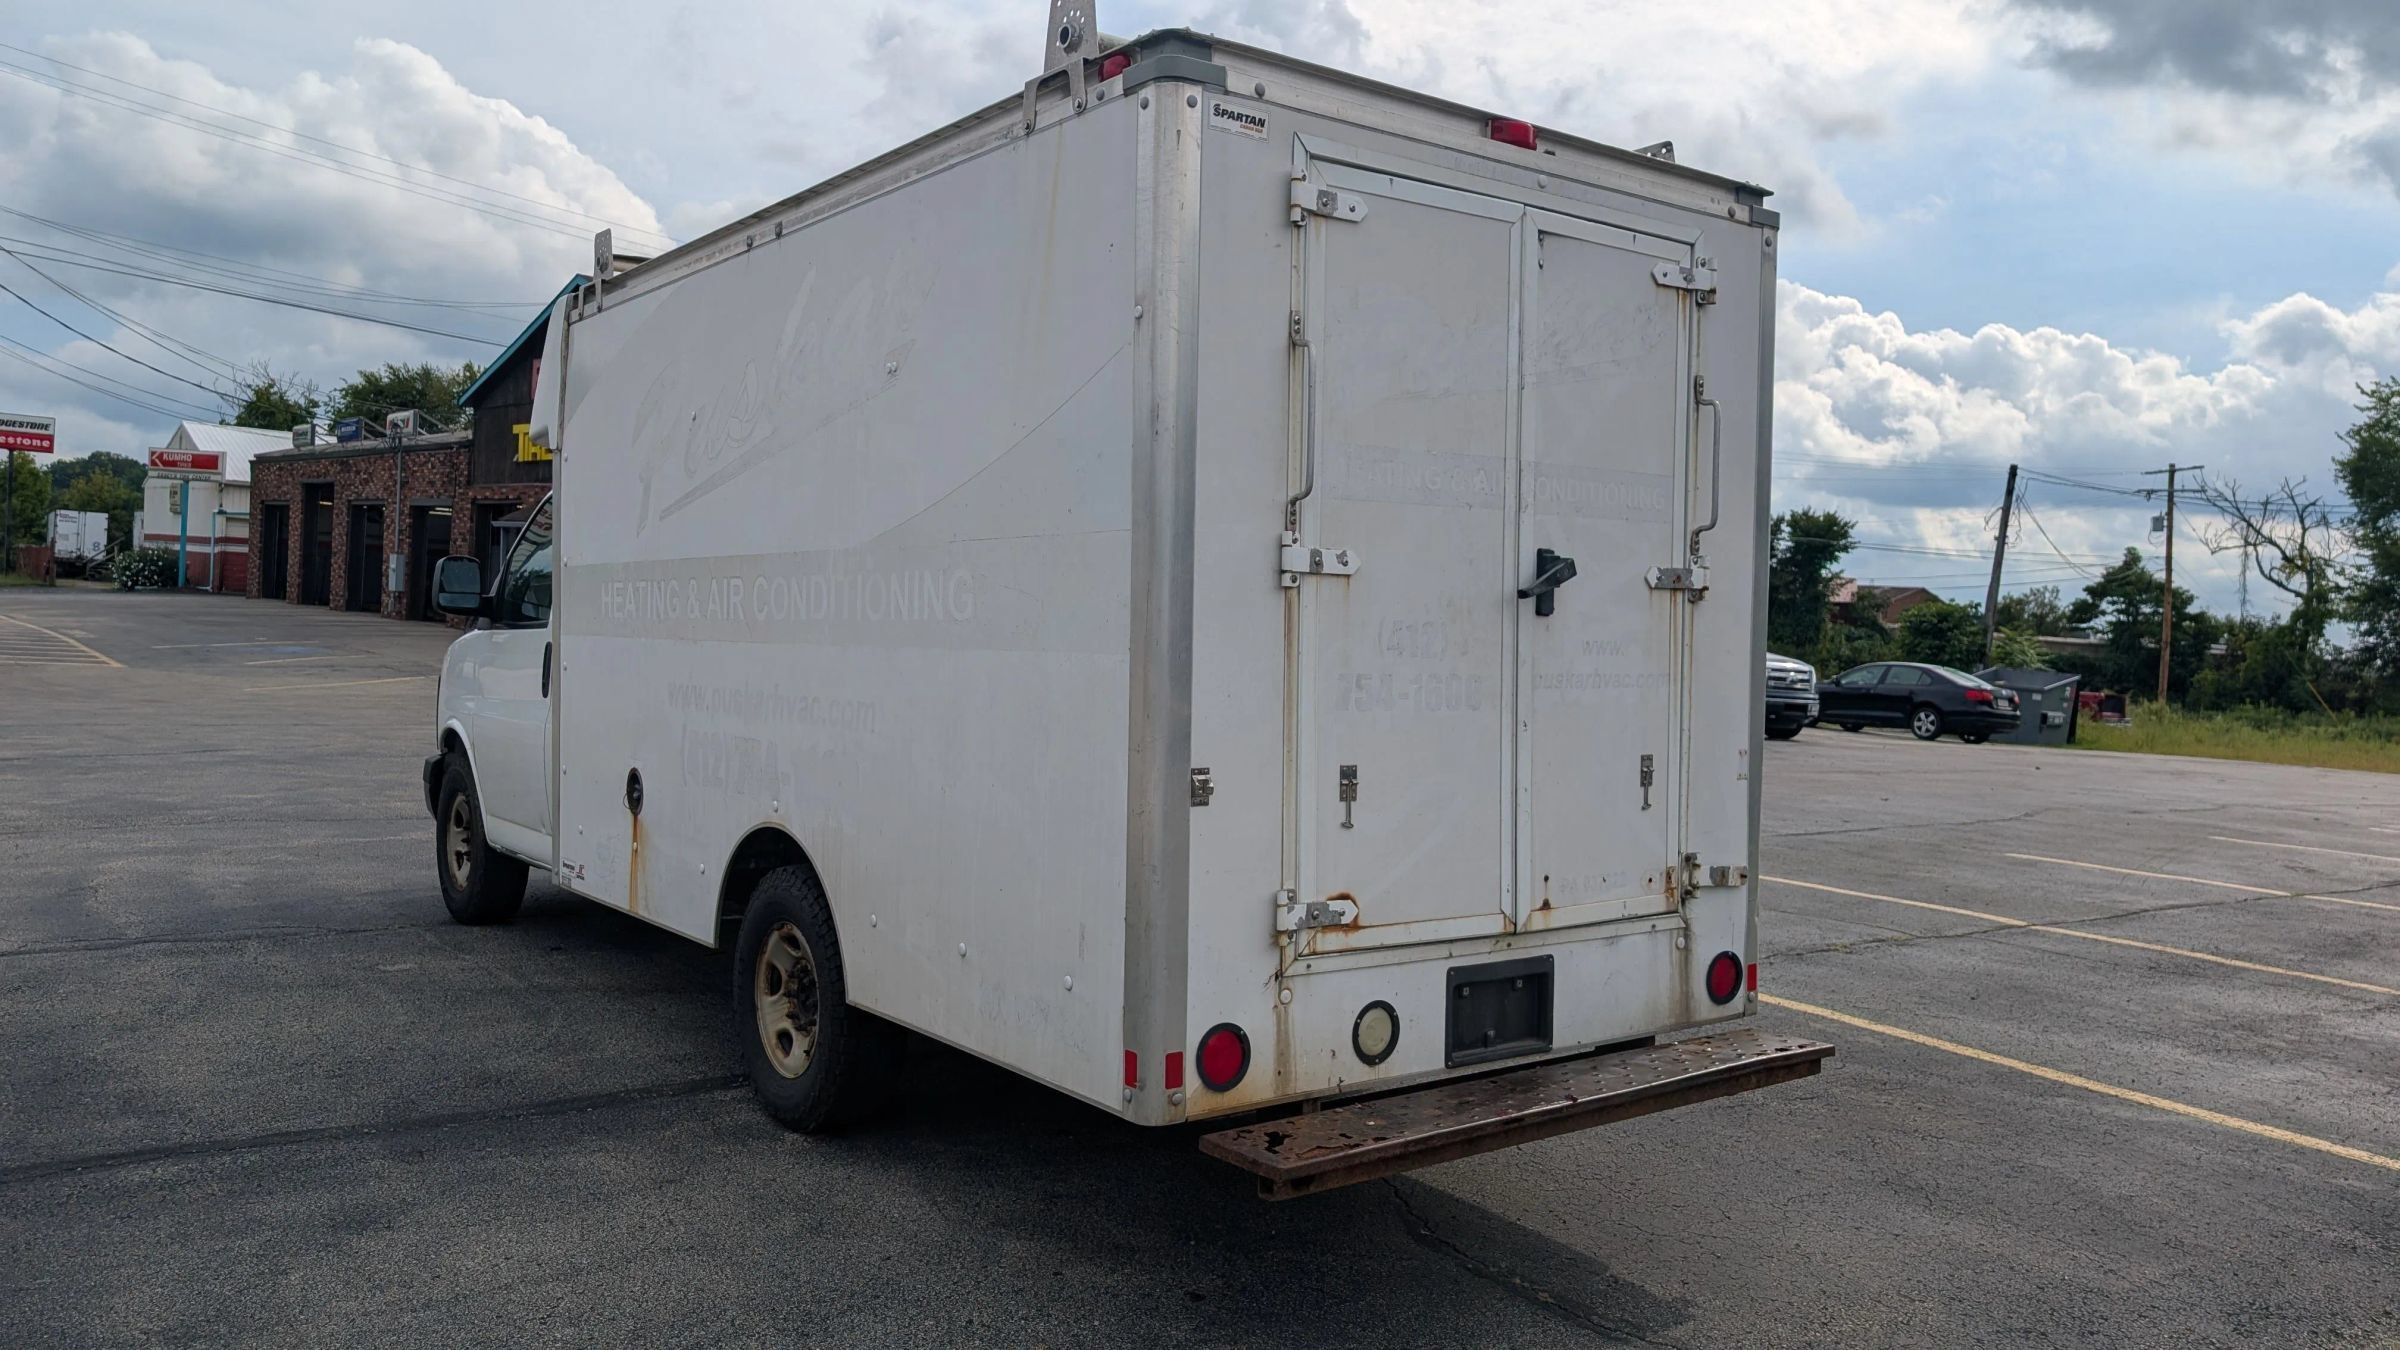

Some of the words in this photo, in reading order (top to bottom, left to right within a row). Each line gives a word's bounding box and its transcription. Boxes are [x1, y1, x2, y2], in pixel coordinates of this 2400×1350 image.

[1213, 103, 1266, 128] SPARTAN
[162, 451, 193, 462] KUMHO
[601, 580, 680, 620] HEATING
[687, 578, 700, 618] &
[706, 577, 745, 620] AIR
[752, 568, 974, 622] CONDITIONING
